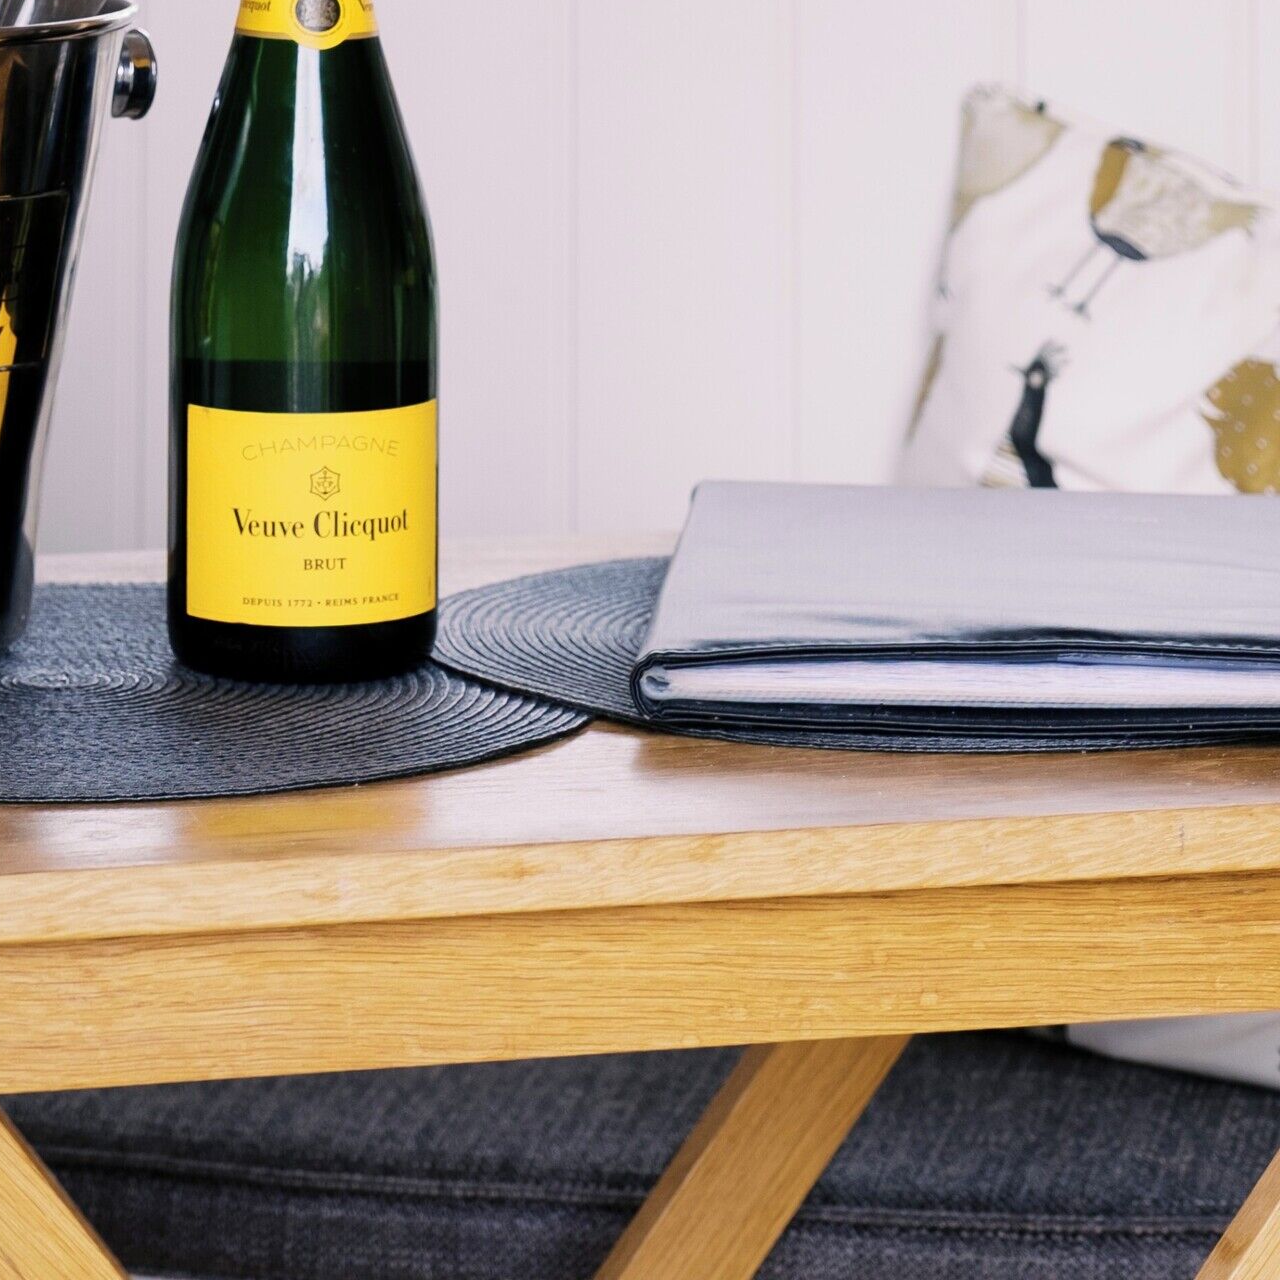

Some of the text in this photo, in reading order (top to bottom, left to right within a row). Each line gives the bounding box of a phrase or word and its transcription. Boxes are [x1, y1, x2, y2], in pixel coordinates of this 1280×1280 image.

[241, 435, 401, 461] CHAMPAGNE
[232, 507, 408, 541] Veuve Clicquot
[303, 557, 347, 571] BRUT
[242, 593, 399, 607] DEPUIS 1772 REIMS FRANCE
